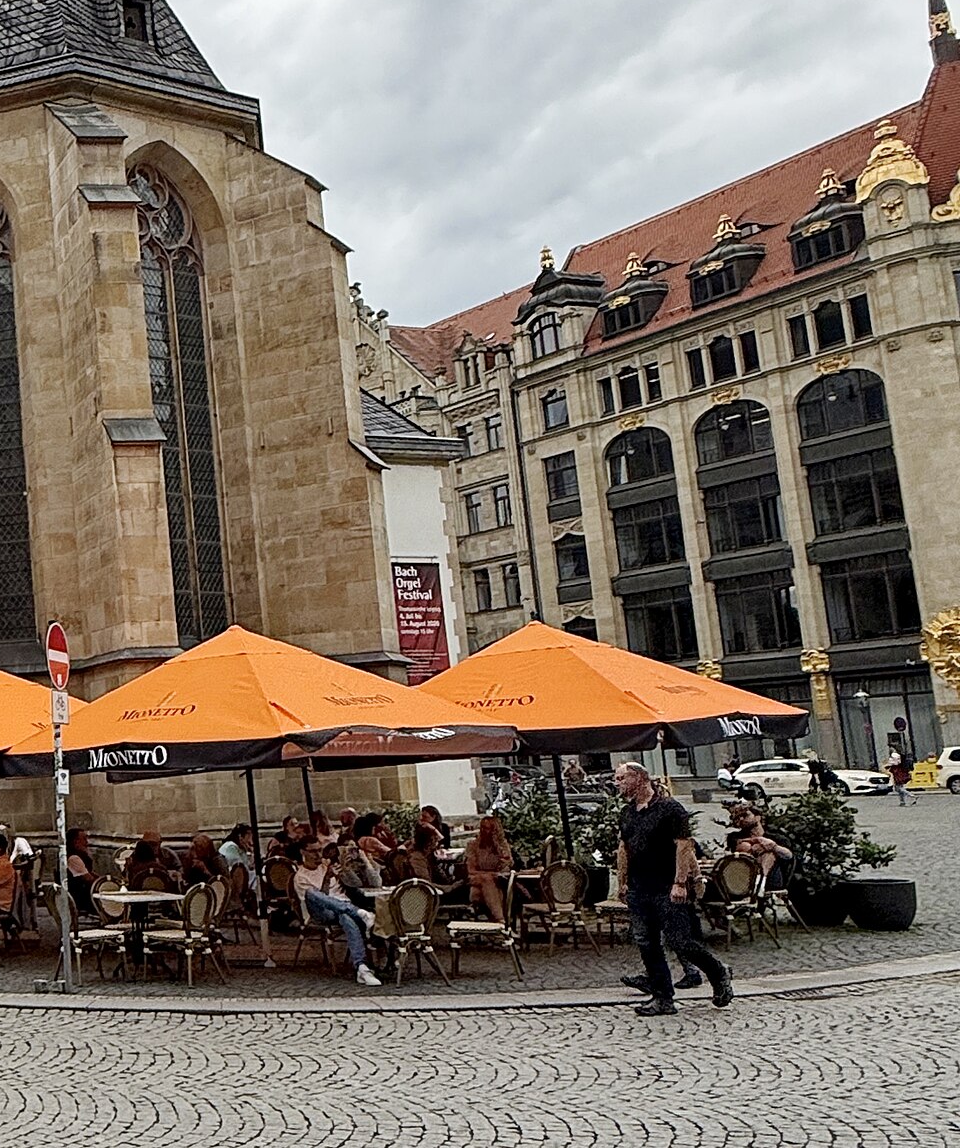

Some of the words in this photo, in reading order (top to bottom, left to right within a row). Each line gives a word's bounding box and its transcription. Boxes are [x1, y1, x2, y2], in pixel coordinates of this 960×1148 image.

[394, 566, 418, 577] Bach
[395, 577, 421, 591] Orgel
[397, 589, 433, 600] Festival
[88, 745, 168, 770] MIONETTO
